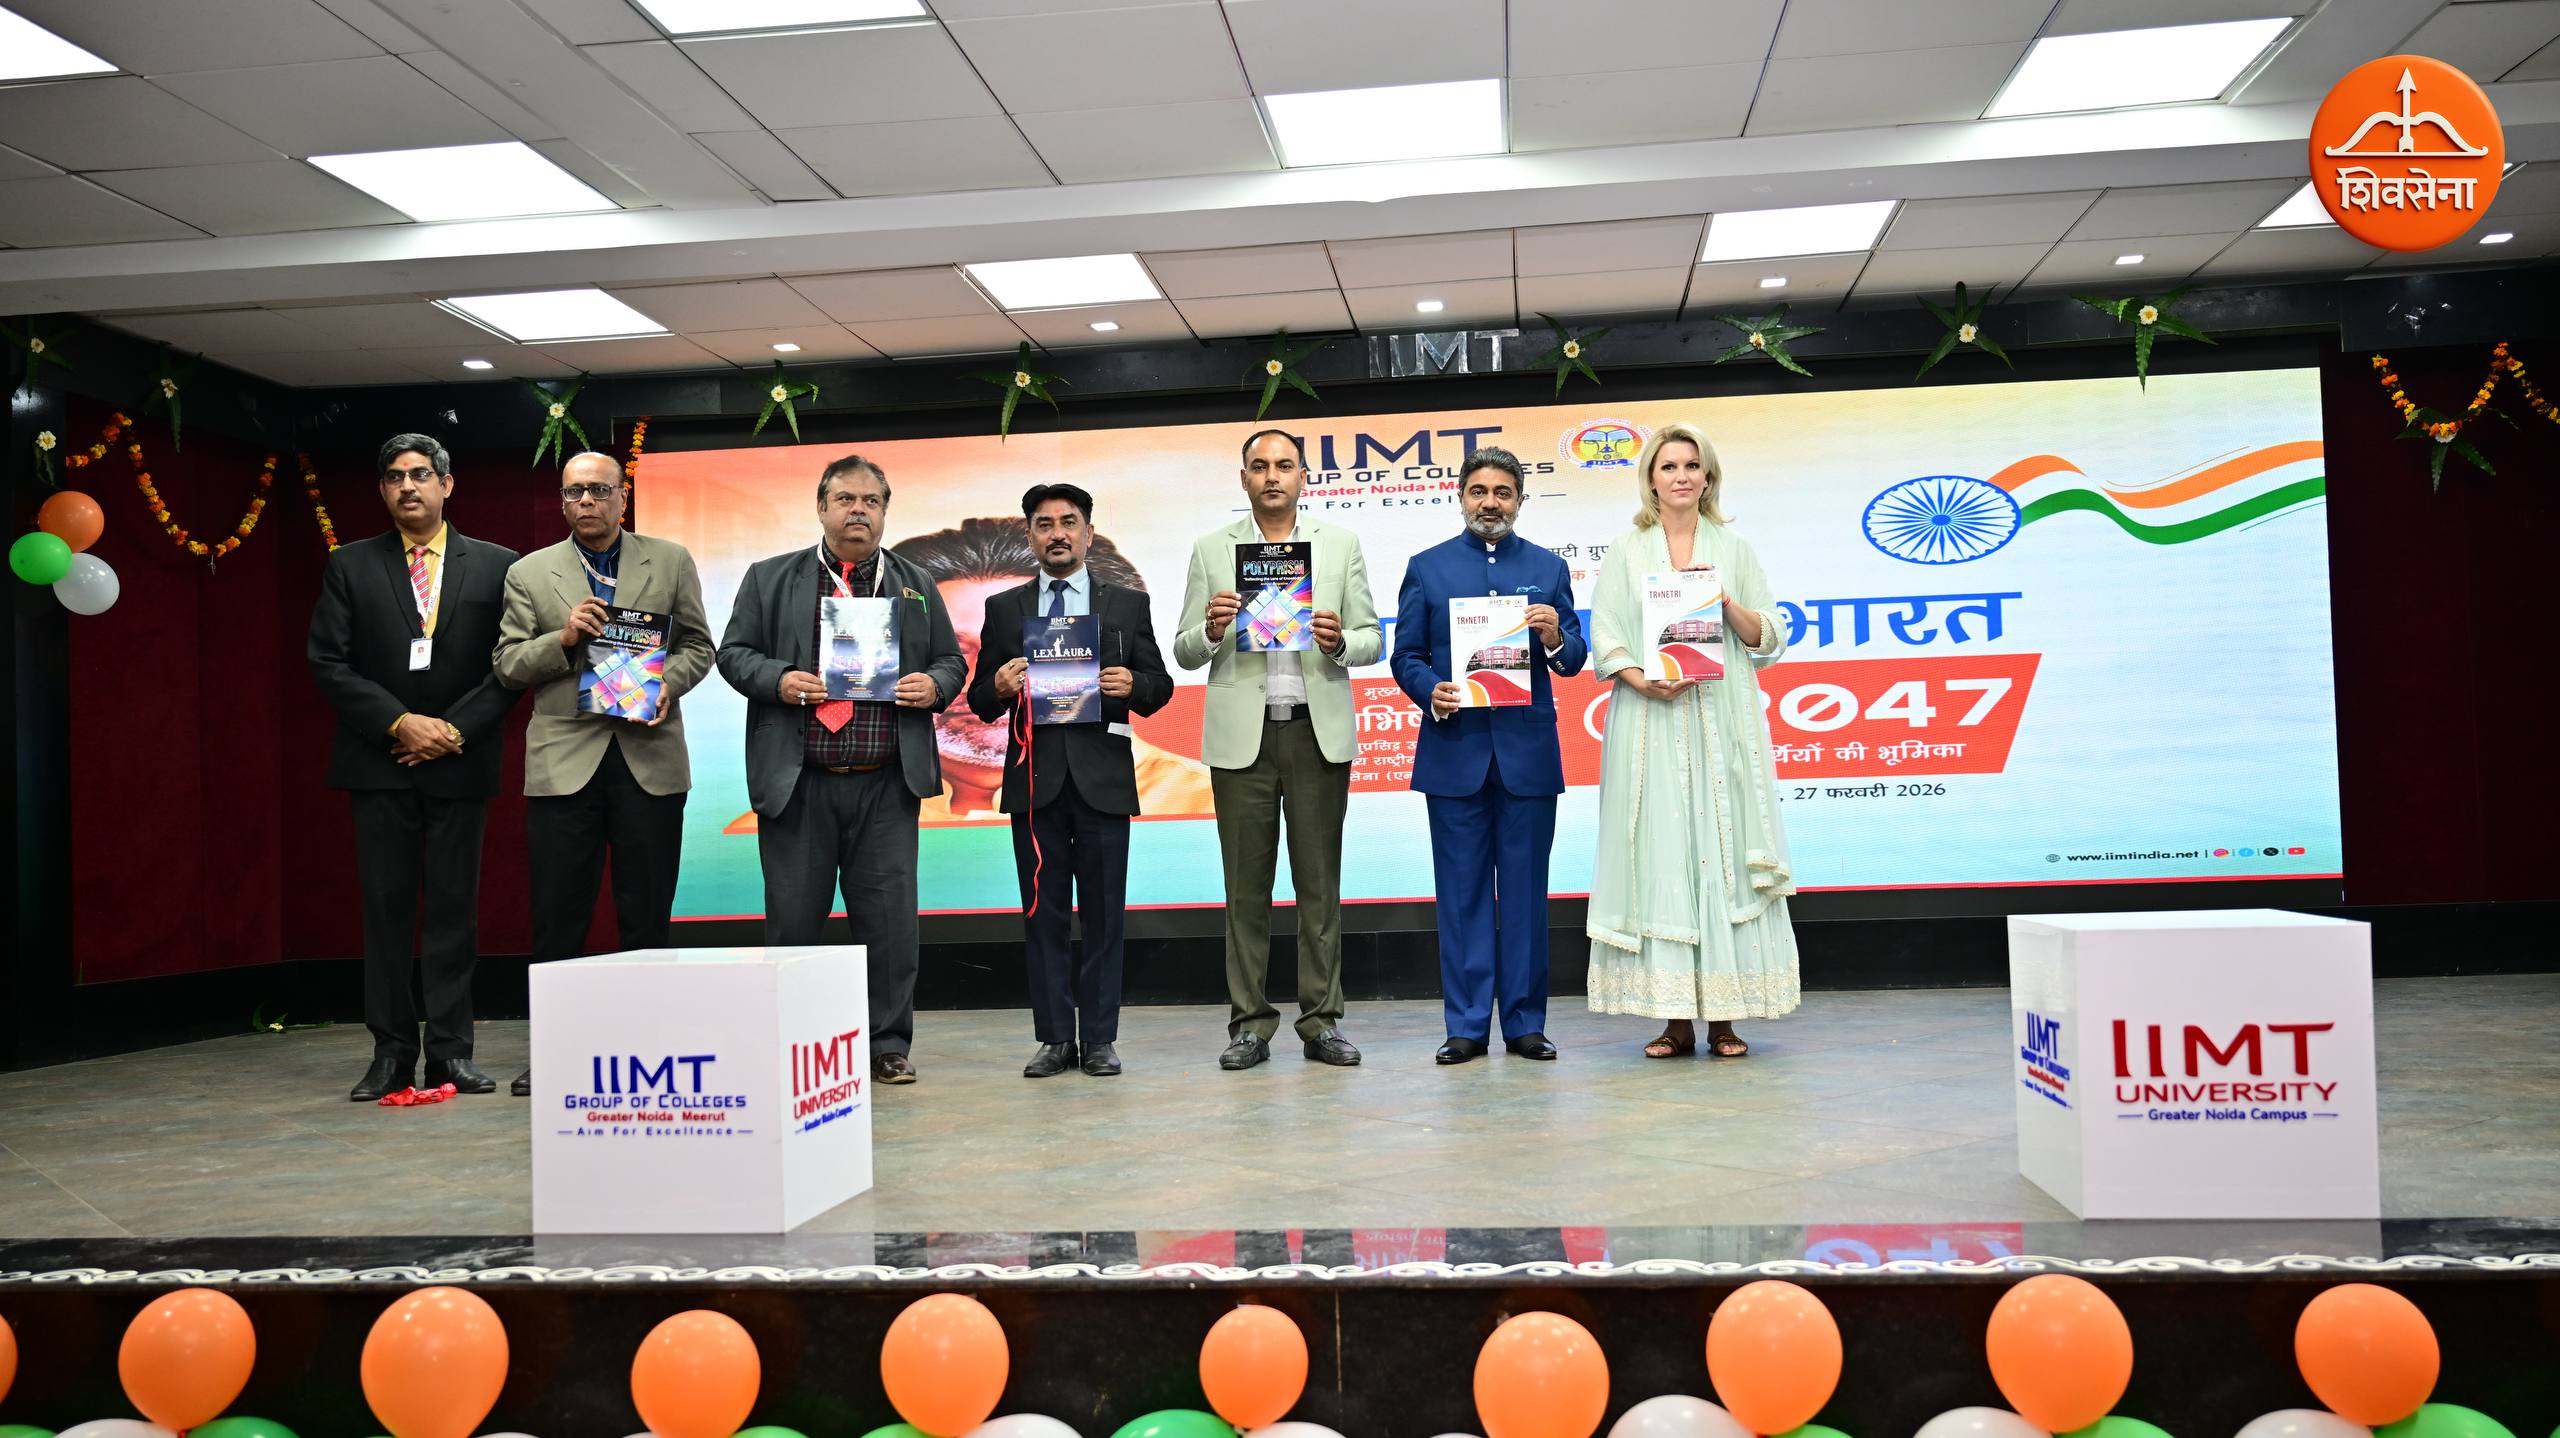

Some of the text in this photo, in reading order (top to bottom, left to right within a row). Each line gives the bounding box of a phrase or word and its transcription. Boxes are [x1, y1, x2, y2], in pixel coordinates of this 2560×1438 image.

[1368, 329, 1519, 379] IIMT
[1355, 470, 1391, 483] OF
[1404, 462, 1555, 481] COLES
[1299, 487, 1364, 498] Greater
[1371, 483, 1426, 495] Noida
[1325, 500, 1366, 510] For
[1242, 560, 1305, 576] POLYPRISM
[1776, 591, 2023, 648] भारत
[604, 623, 662, 647] OLYPRISM
[1758, 677, 2013, 733] 047
[1834, 742, 1869, 761] की
[1878, 740, 1967, 766] भूमिका
[1794, 782, 1947, 800] 27 फरवरी 2026
[2066, 850, 2199, 862] www.iimtindia.net
[2027, 1011, 2060, 1060] IIMT
[2112, 1019, 2335, 1077] IIMT
[593, 1055, 716, 1094] IIMT
[792, 1028, 860, 1098] IIMT
[564, 1094, 747, 1109] GROUP OF COLLEGES
[794, 1077, 861, 1120] UNIVERSITY
[2115, 1081, 2337, 1104] UNIVERSITY
[587, 1111, 725, 1122] Greater Noida Meerut
[2148, 1108, 2307, 1122] Greater Noida Campus
[577, 1127, 733, 1136] Aim For Excellence
